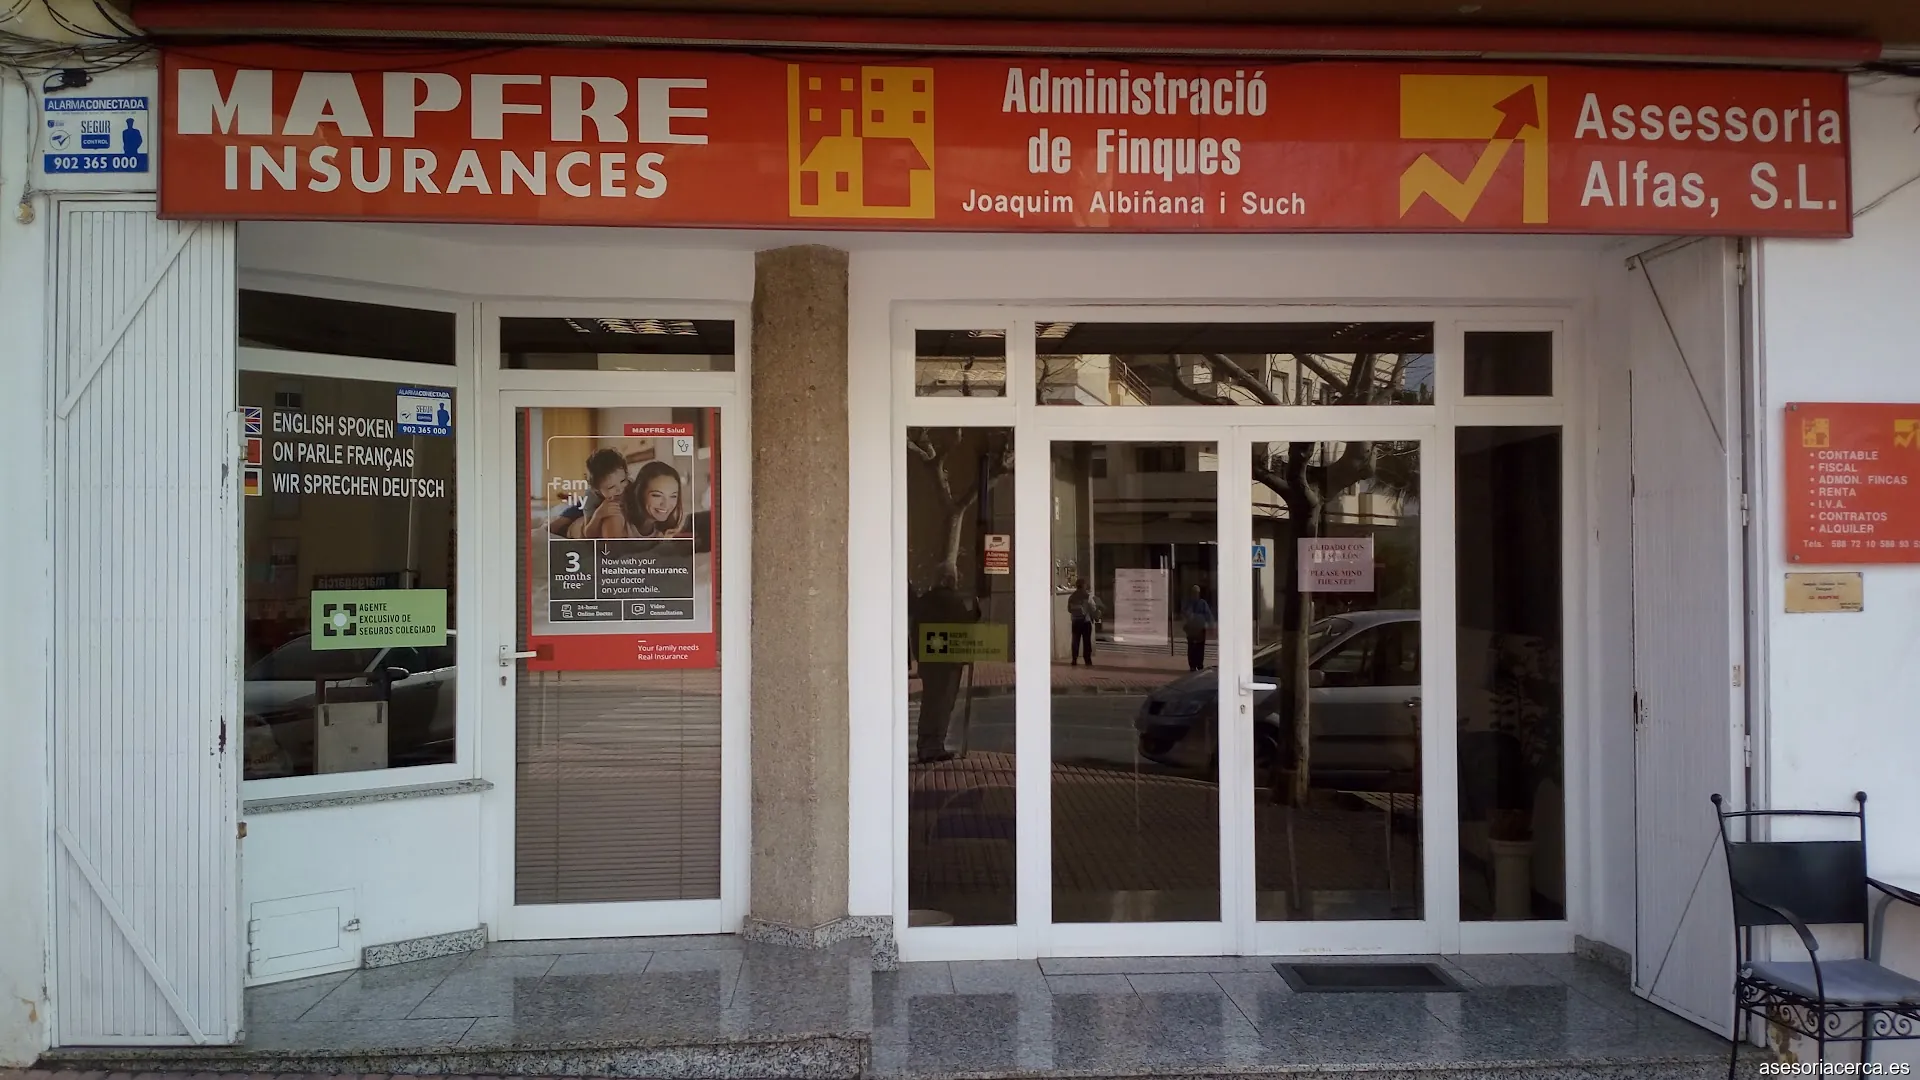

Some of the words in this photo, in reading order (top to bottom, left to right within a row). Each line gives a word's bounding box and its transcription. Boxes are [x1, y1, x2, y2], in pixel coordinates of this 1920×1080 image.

[1002, 67, 1267, 116] Administració
[48, 99, 145, 110] ALARMACONECTADA
[177, 68, 708, 145] MAPFRE
[1574, 92, 1841, 144] Assessoria
[81, 120, 111, 134] SEGUR
[1028, 128, 1071, 174] de
[1096, 128, 1241, 182] Finques
[54, 157, 79, 169] 902
[83, 157, 108, 169] 365
[112, 157, 138, 169] 000
[224, 145, 668, 199] INSURANCES
[1580, 159, 1719, 218] Alfas,
[1750, 161, 1837, 210] S.L.
[962, 188, 1074, 218] Joaquim
[1089, 189, 1205, 215] Albiñana
[1219, 191, 1226, 214] i
[1242, 192, 1305, 215] Such
[398, 388, 450, 398] ALARMACONECTADA
[273, 411, 334, 436] ENGLISH
[338, 413, 394, 439] SPOKEN
[402, 425, 416, 434] 902
[418, 426, 431, 434] 365
[433, 427, 447, 435] 000
[272, 441, 293, 462] ON
[298, 442, 343, 465] PARLE
[347, 446, 414, 471] FRANÇAIS
[1818, 450, 1879, 461] CONTABLE
[1818, 463, 1858, 472] FISCAL
[272, 472, 300, 495] WIR
[304, 474, 378, 497] SPRECHEN
[382, 477, 445, 498] DEUTSCH
[1819, 475, 1863, 485] ADMON.
[1868, 475, 1908, 485] FINCAS
[1819, 487, 1857, 497] RENTA
[1818, 500, 1846, 509] I.V.A.
[1818, 511, 1888, 521] CONTRATOS
[1819, 524, 1875, 533] ALQUILER
[1803, 540, 1824, 548] Tels.
[1851, 540, 1861, 548] 72
[1866, 540, 1876, 548] 10
[565, 551, 580, 573] 3
[638, 558, 656, 567] your
[555, 572, 592, 581] months
[601, 567, 646, 575] Healthcare
[647, 567, 689, 575] Insurance,
[601, 577, 619, 586] your
[612, 587, 631, 596] your
[632, 585, 661, 594] mobile.
[359, 603, 388, 611] AGENTE
[359, 614, 400, 624] EXCLUSIVO
[401, 614, 412, 623] DE
[359, 626, 394, 636] SEGUROS
[395, 625, 436, 635] COLEGIADO
[655, 644, 677, 653] family
[678, 644, 700, 652] needs
